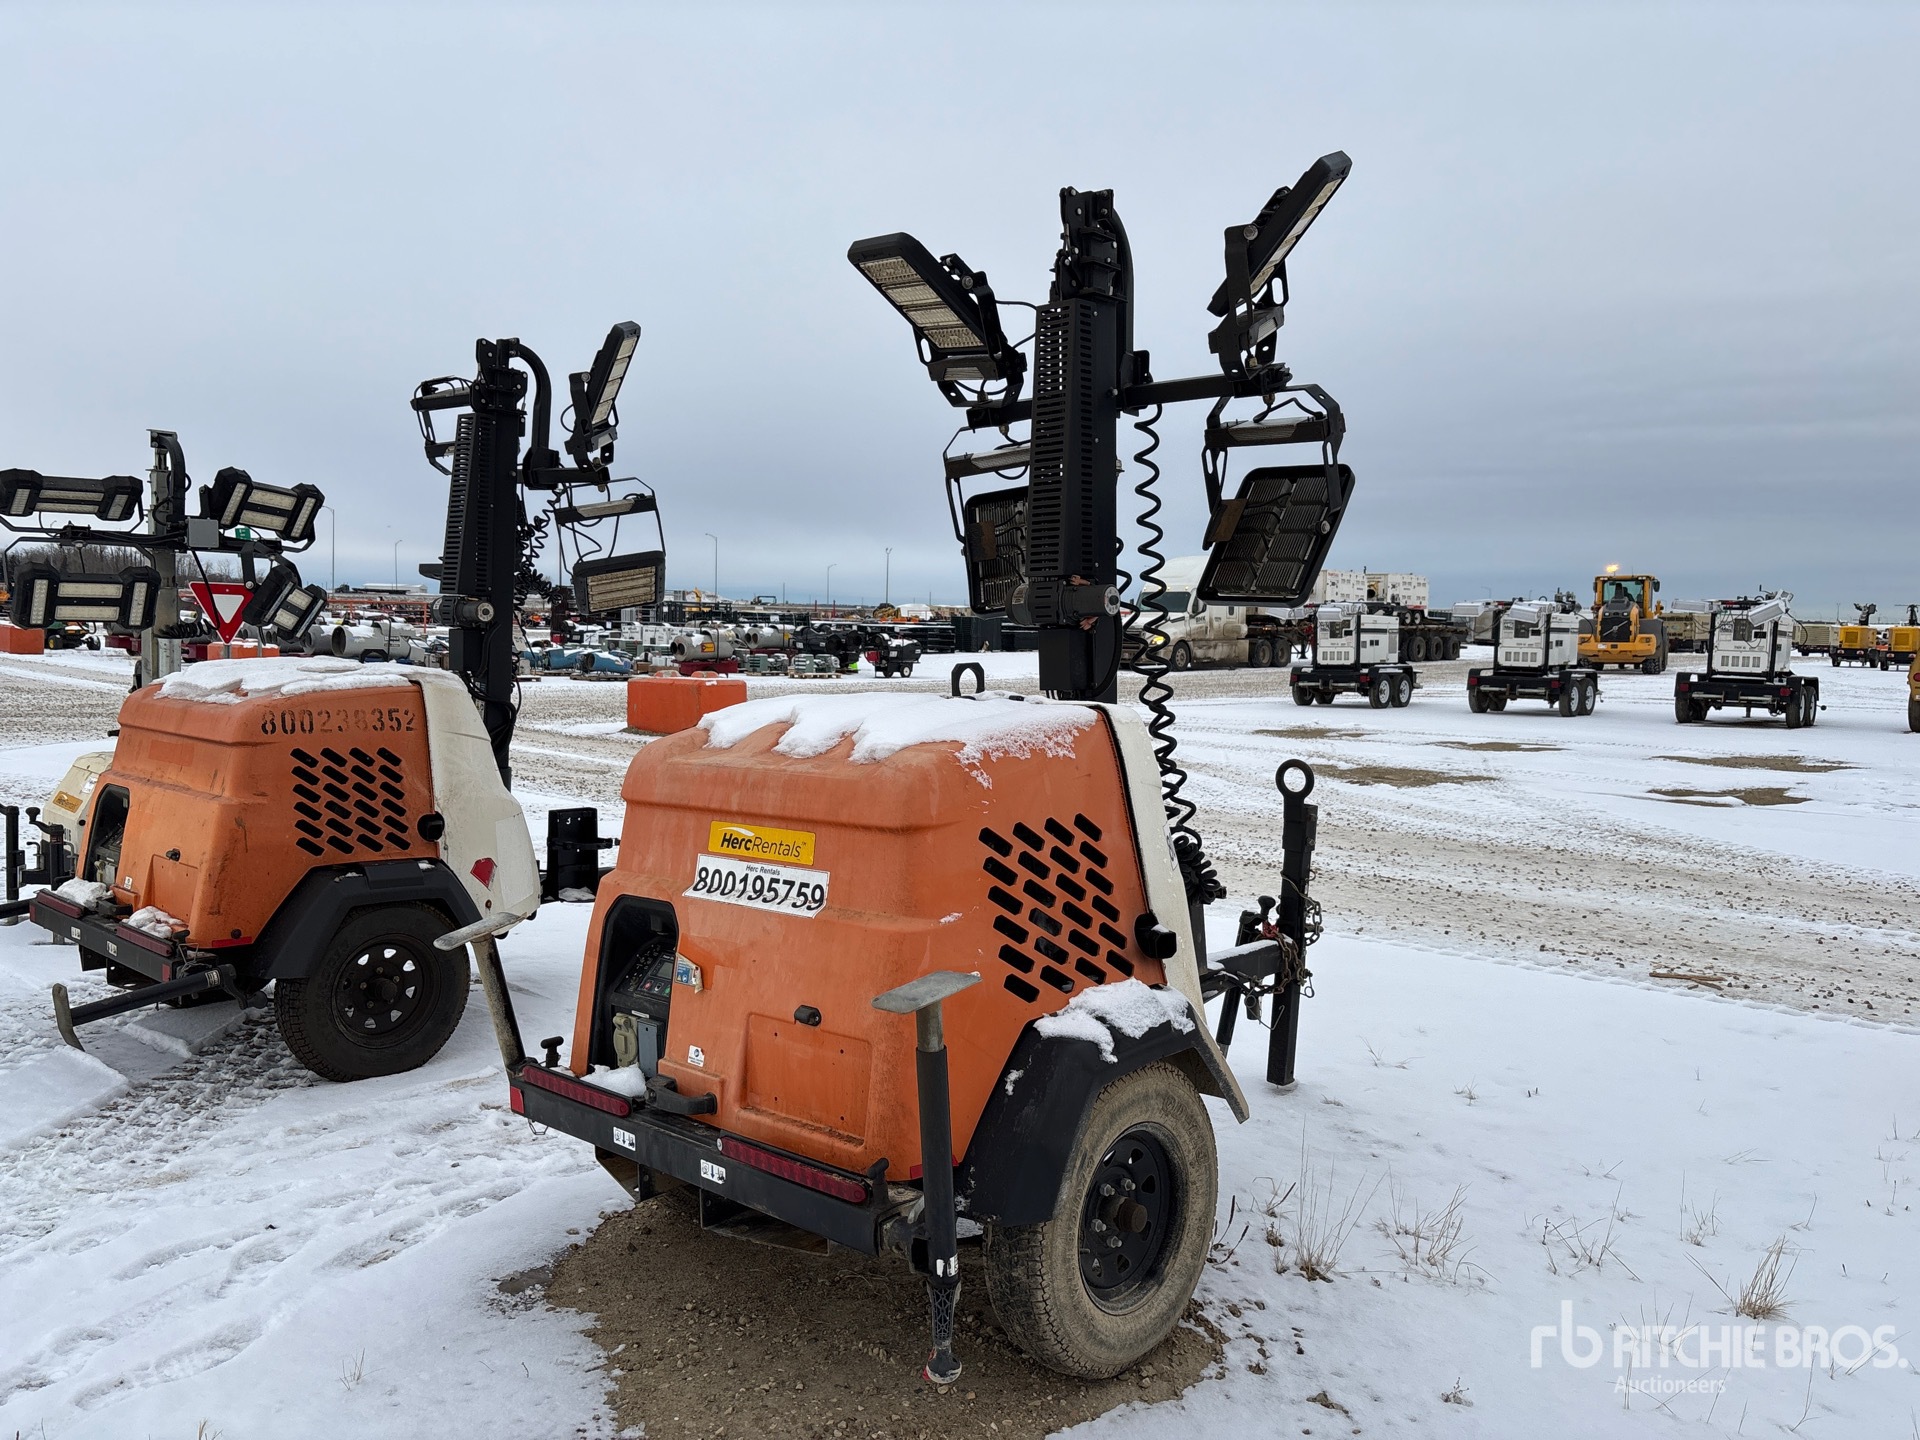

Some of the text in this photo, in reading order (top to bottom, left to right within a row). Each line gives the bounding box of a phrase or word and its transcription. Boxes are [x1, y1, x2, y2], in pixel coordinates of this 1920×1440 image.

[262, 708, 417, 735] 800238352
[745, 864, 781, 876] Herc Rentals
[693, 866, 825, 911] 800195759
